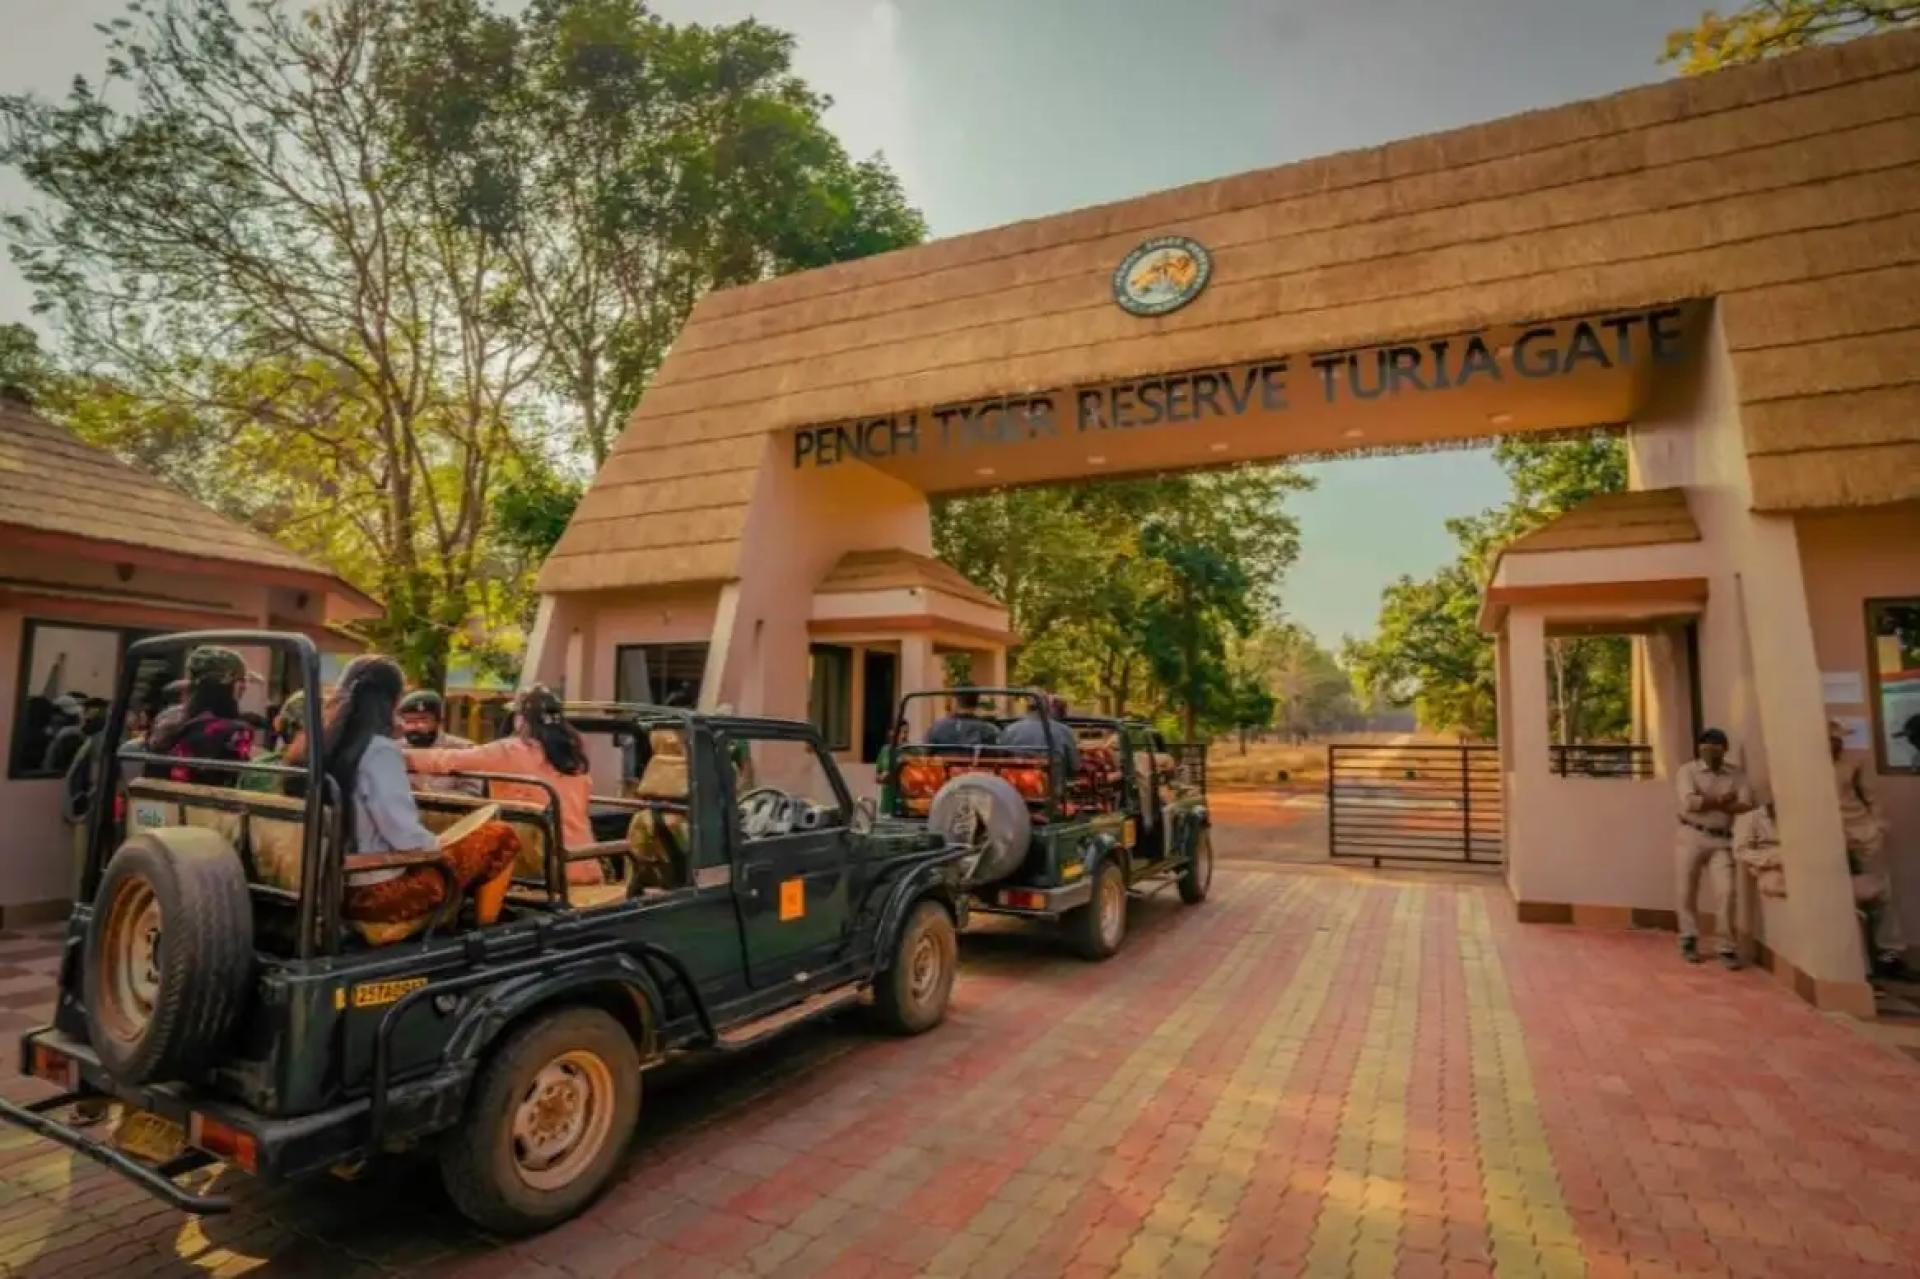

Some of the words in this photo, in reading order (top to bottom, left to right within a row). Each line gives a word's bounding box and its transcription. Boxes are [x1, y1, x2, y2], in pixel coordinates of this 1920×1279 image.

[794, 413, 919, 468] PENCH
[932, 397, 1059, 447] TIGER
[1077, 361, 1289, 432] RESERVE
[1310, 333, 1501, 404] TURIA
[1512, 307, 1687, 378] GATE
